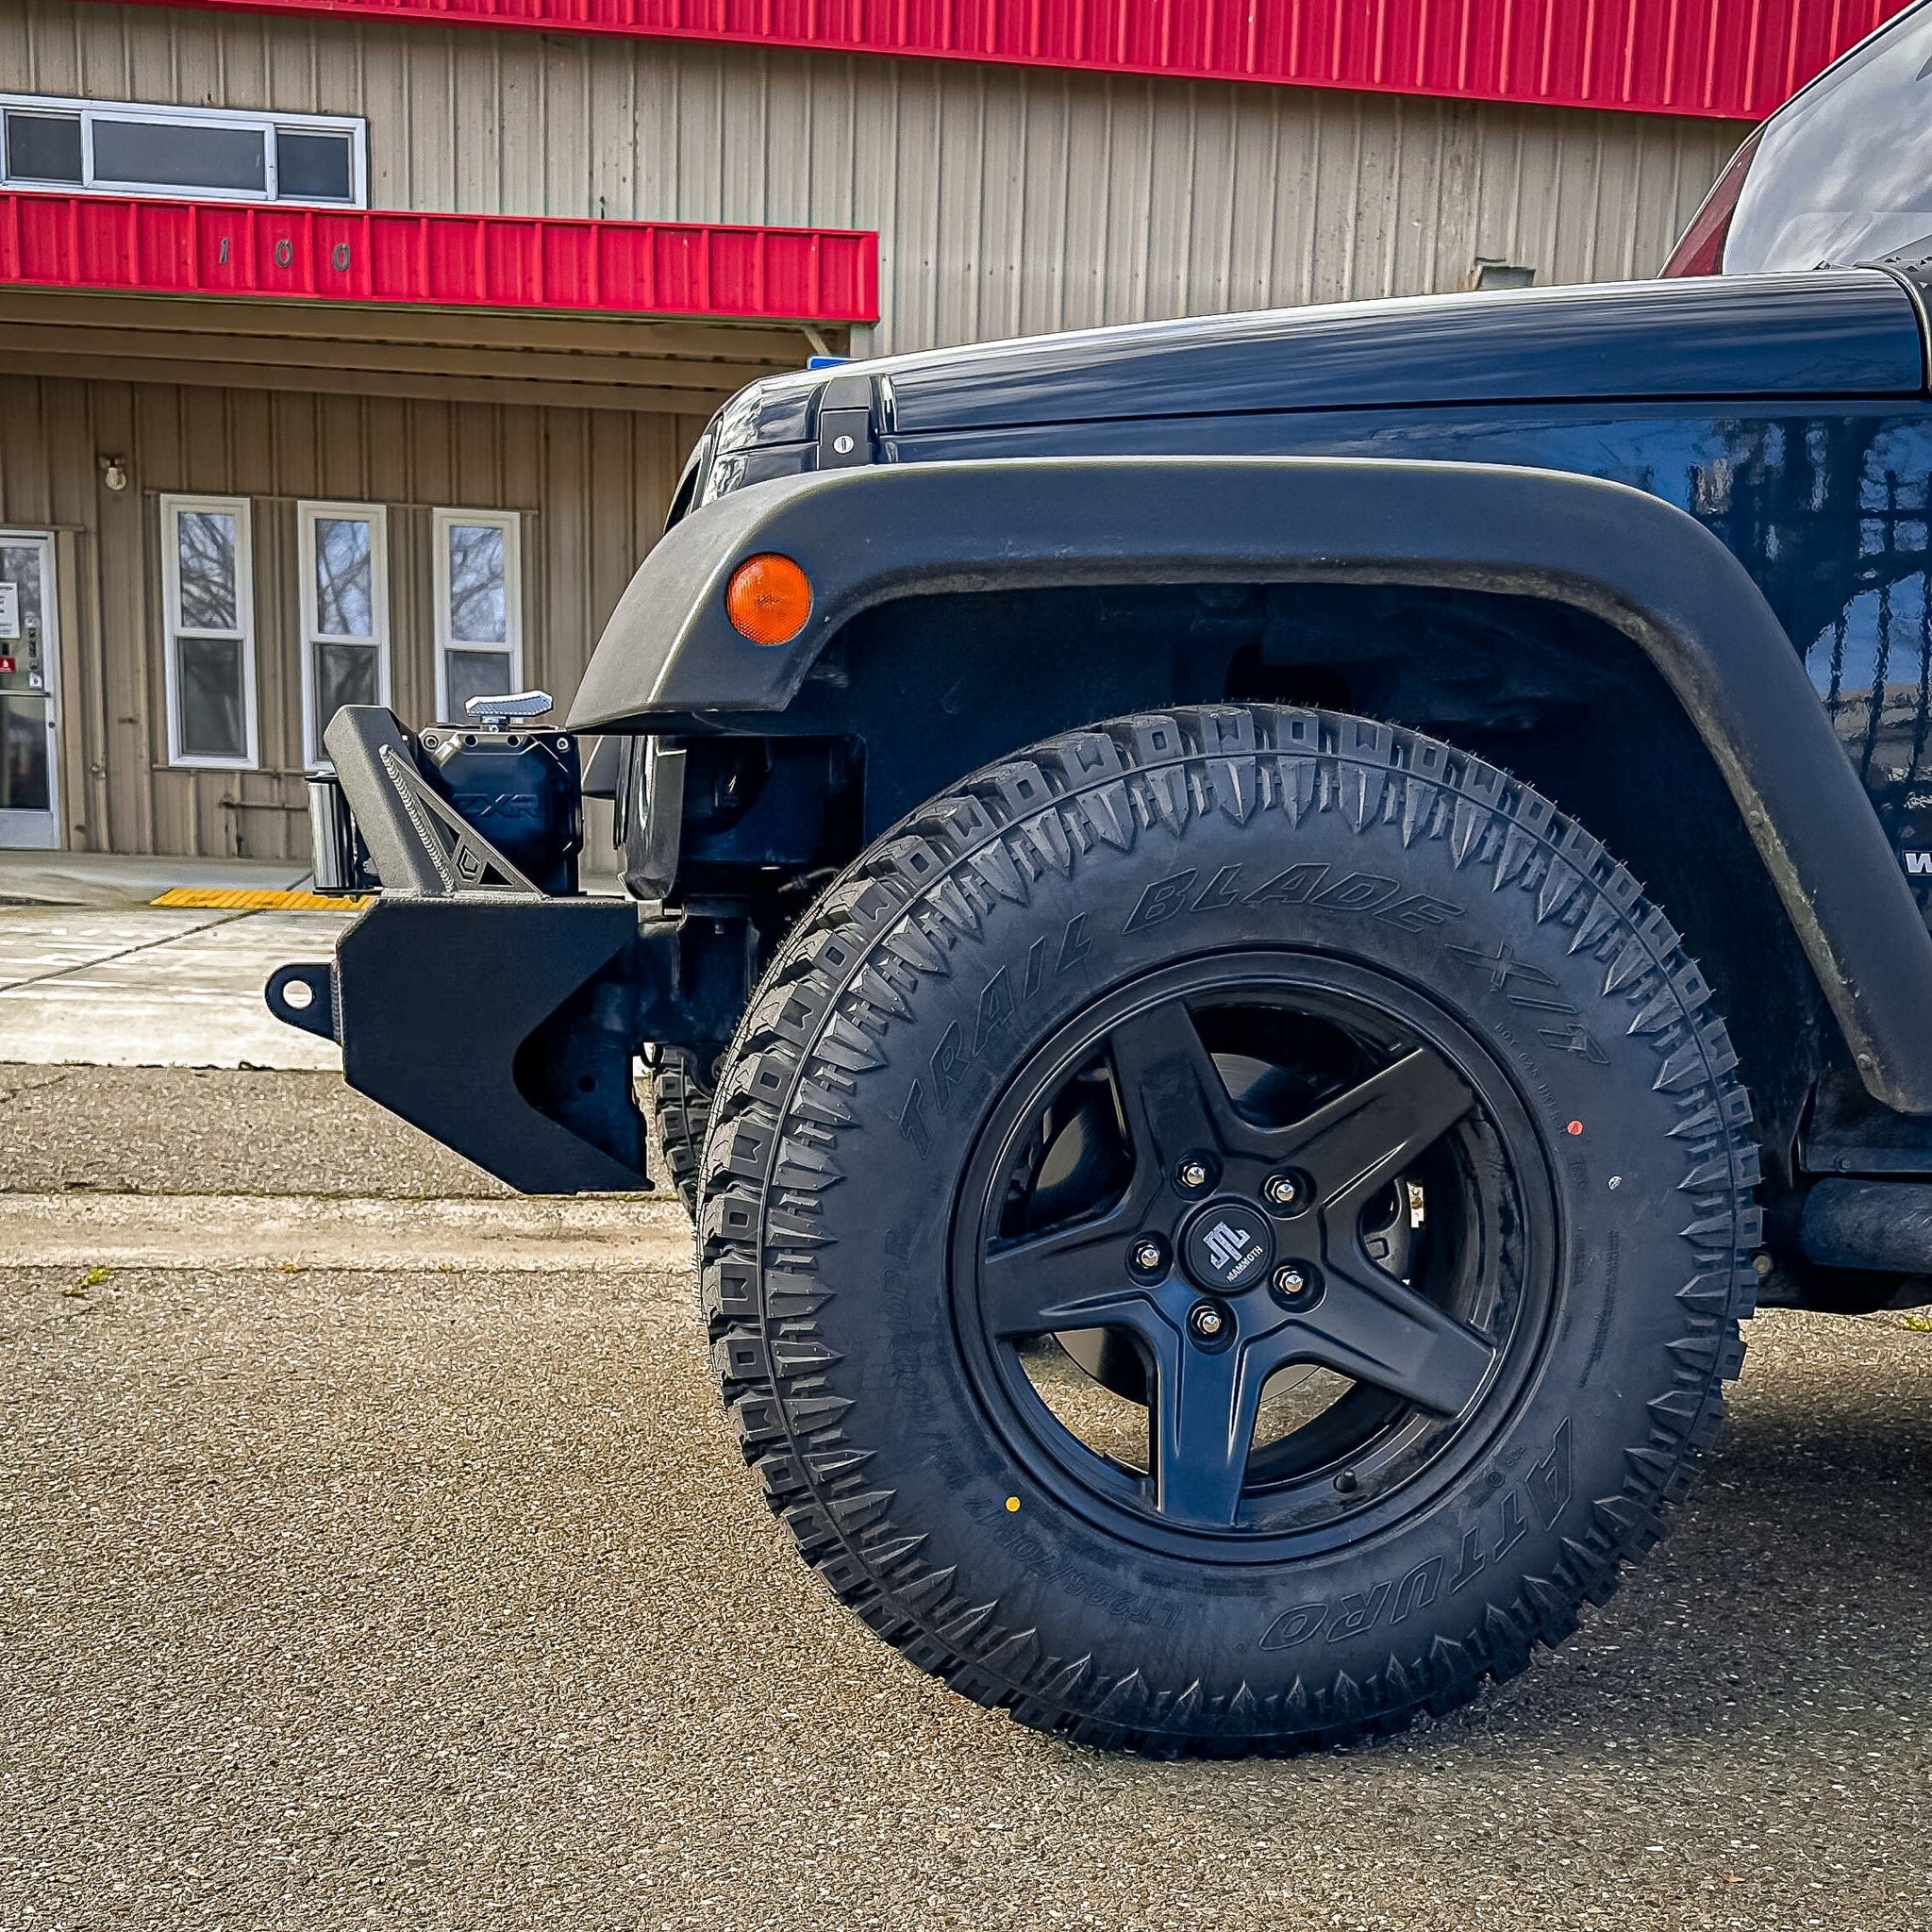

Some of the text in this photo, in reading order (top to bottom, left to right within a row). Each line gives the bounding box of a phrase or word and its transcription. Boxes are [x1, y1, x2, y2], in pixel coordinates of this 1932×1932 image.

[219, 237, 351, 272] 100
[898, 912, 1094, 1159] TRAIL
[1122, 862, 1466, 936] BLADE
[1226, 1245, 1263, 1282] MAMMOTH
[1258, 1416, 1573, 1652] ATTURO
